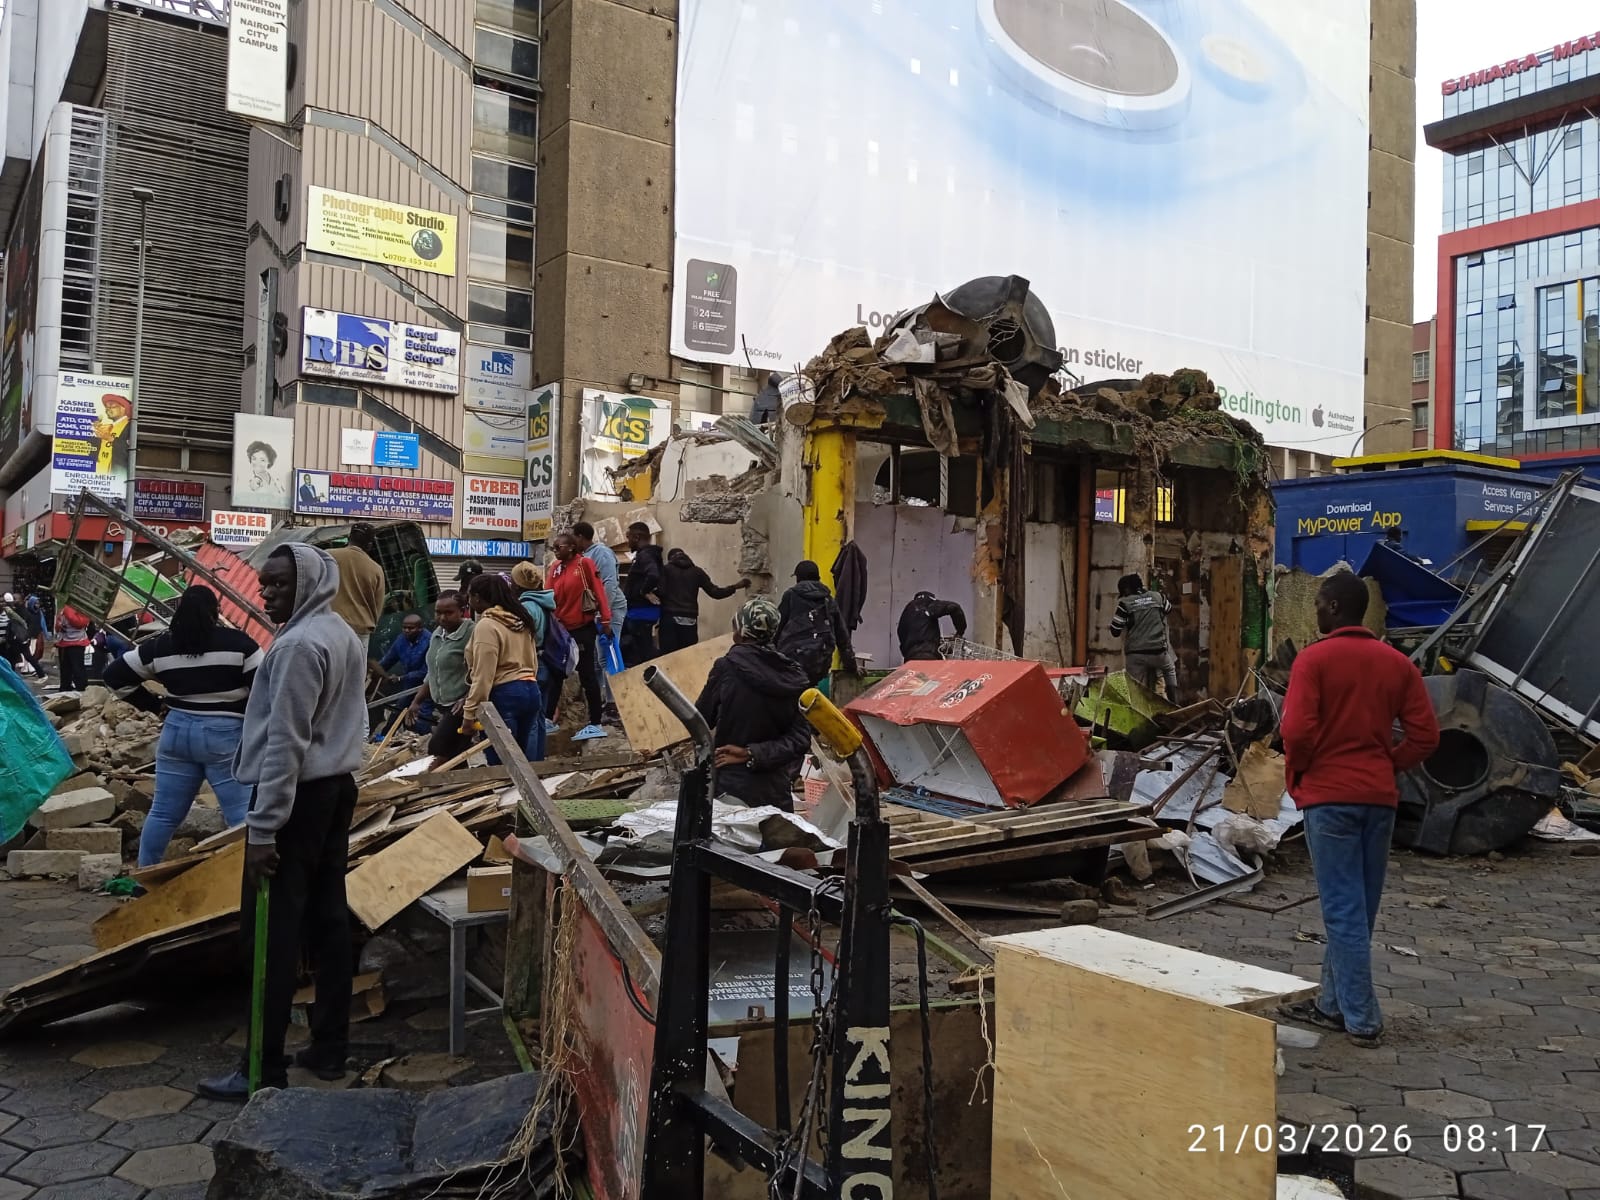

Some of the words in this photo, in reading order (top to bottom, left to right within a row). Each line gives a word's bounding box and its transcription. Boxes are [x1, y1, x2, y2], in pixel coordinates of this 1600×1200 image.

[233, 0, 286, 20] UNIVERSITY
[240, 17, 279, 35] NAIROBI
[246, 28, 269, 40] CITY
[238, 36, 279, 52] CAMPUS
[1441, 53, 1542, 96] SIMARA
[322, 194, 403, 224] Photography
[407, 212, 445, 231] Studio
[703, 289, 720, 298] FREE
[699, 308, 710, 318] 24
[857, 303, 893, 328] Loo
[698, 322, 705, 331] 6
[405, 327, 438, 341] Royal
[305, 335, 389, 370] RBS
[405, 340, 457, 356] Business
[405, 351, 445, 366] School
[763, 349, 783, 360] Apply
[481, 359, 514, 375] RBS
[1084, 348, 1143, 374] sticker
[338, 367, 350, 378] for
[418, 371, 436, 380] Floor
[96, 380, 130, 389] COLLEGE
[57, 405, 97, 414] COURSES
[60, 399, 95, 408] KASNEB
[1217, 385, 1301, 424] Redington
[1328, 411, 1355, 423] Authorized
[530, 415, 549, 438] ICS
[65, 472, 116, 481] ENROLLMENT
[329, 472, 376, 490] RCM
[378, 477, 454, 497] COLLEGE
[469, 478, 519, 496] CYBER
[134, 492, 150, 500] NLINE
[329, 487, 361, 496] PHYSICAL
[369, 490, 392, 498] ONLINE
[393, 491, 421, 500] CLASSES
[421, 493, 454, 502] AVAILABLE
[329, 494, 353, 502] KNEC
[523, 489, 552, 501] TECHNICAL
[1482, 484, 1507, 497] Access
[1510, 488, 1532, 502] Kenya
[499, 497, 521, 508] PHOTOS
[525, 501, 549, 513] COLLEGE
[1326, 501, 1372, 514] Download
[1484, 500, 1514, 514] Services
[391, 507, 422, 515] CENTRE
[1095, 511, 1113, 519] ACCA
[214, 512, 267, 528] CYBER
[486, 518, 519, 529] FLOOR
[535, 519, 549, 530] Floor
[1298, 517, 1364, 536] MyPower
[1370, 511, 1402, 529] App
[214, 527, 244, 537] PASSPORT
[245, 529, 269, 538] PHOTOS
[430, 539, 451, 555] URISM
[714, 992, 767, 1001] PROPERTY
